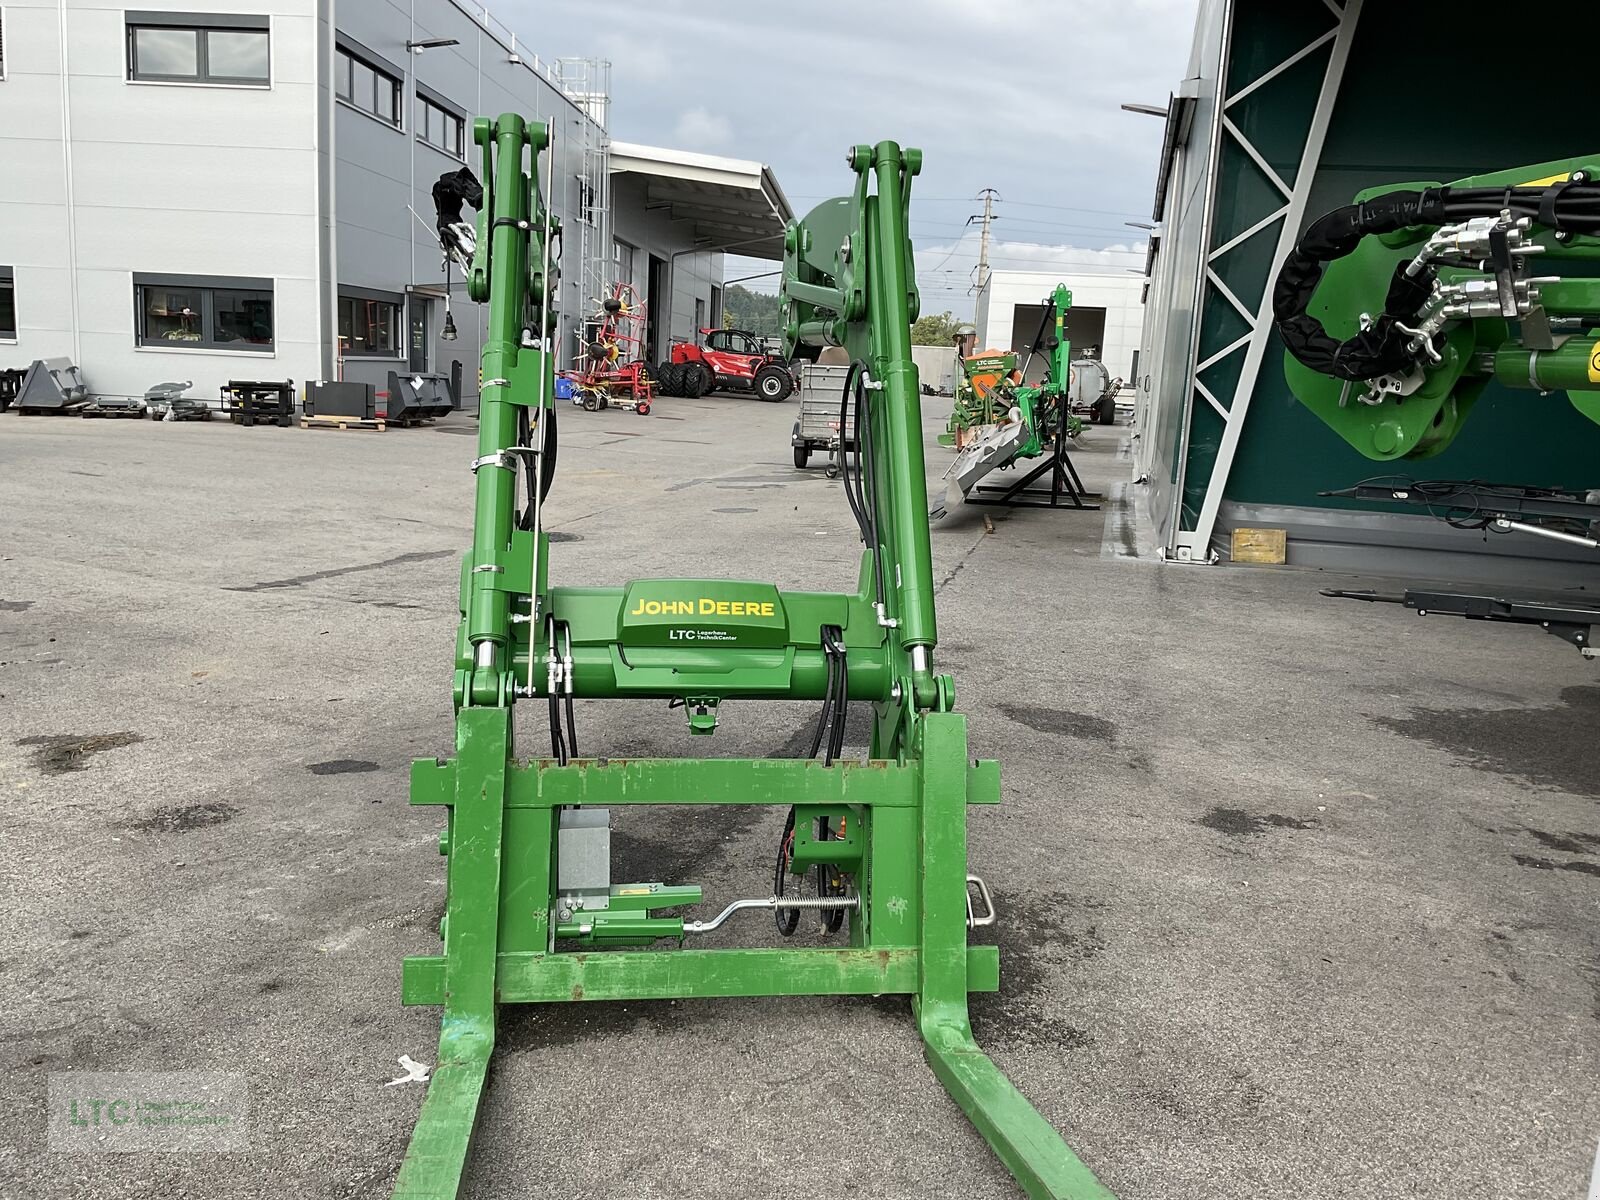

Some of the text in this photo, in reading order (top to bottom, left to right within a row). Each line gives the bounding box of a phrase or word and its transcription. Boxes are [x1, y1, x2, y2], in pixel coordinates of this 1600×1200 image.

[632, 598, 775, 616] JOHN DEERE
[669, 629, 696, 640] LTC
